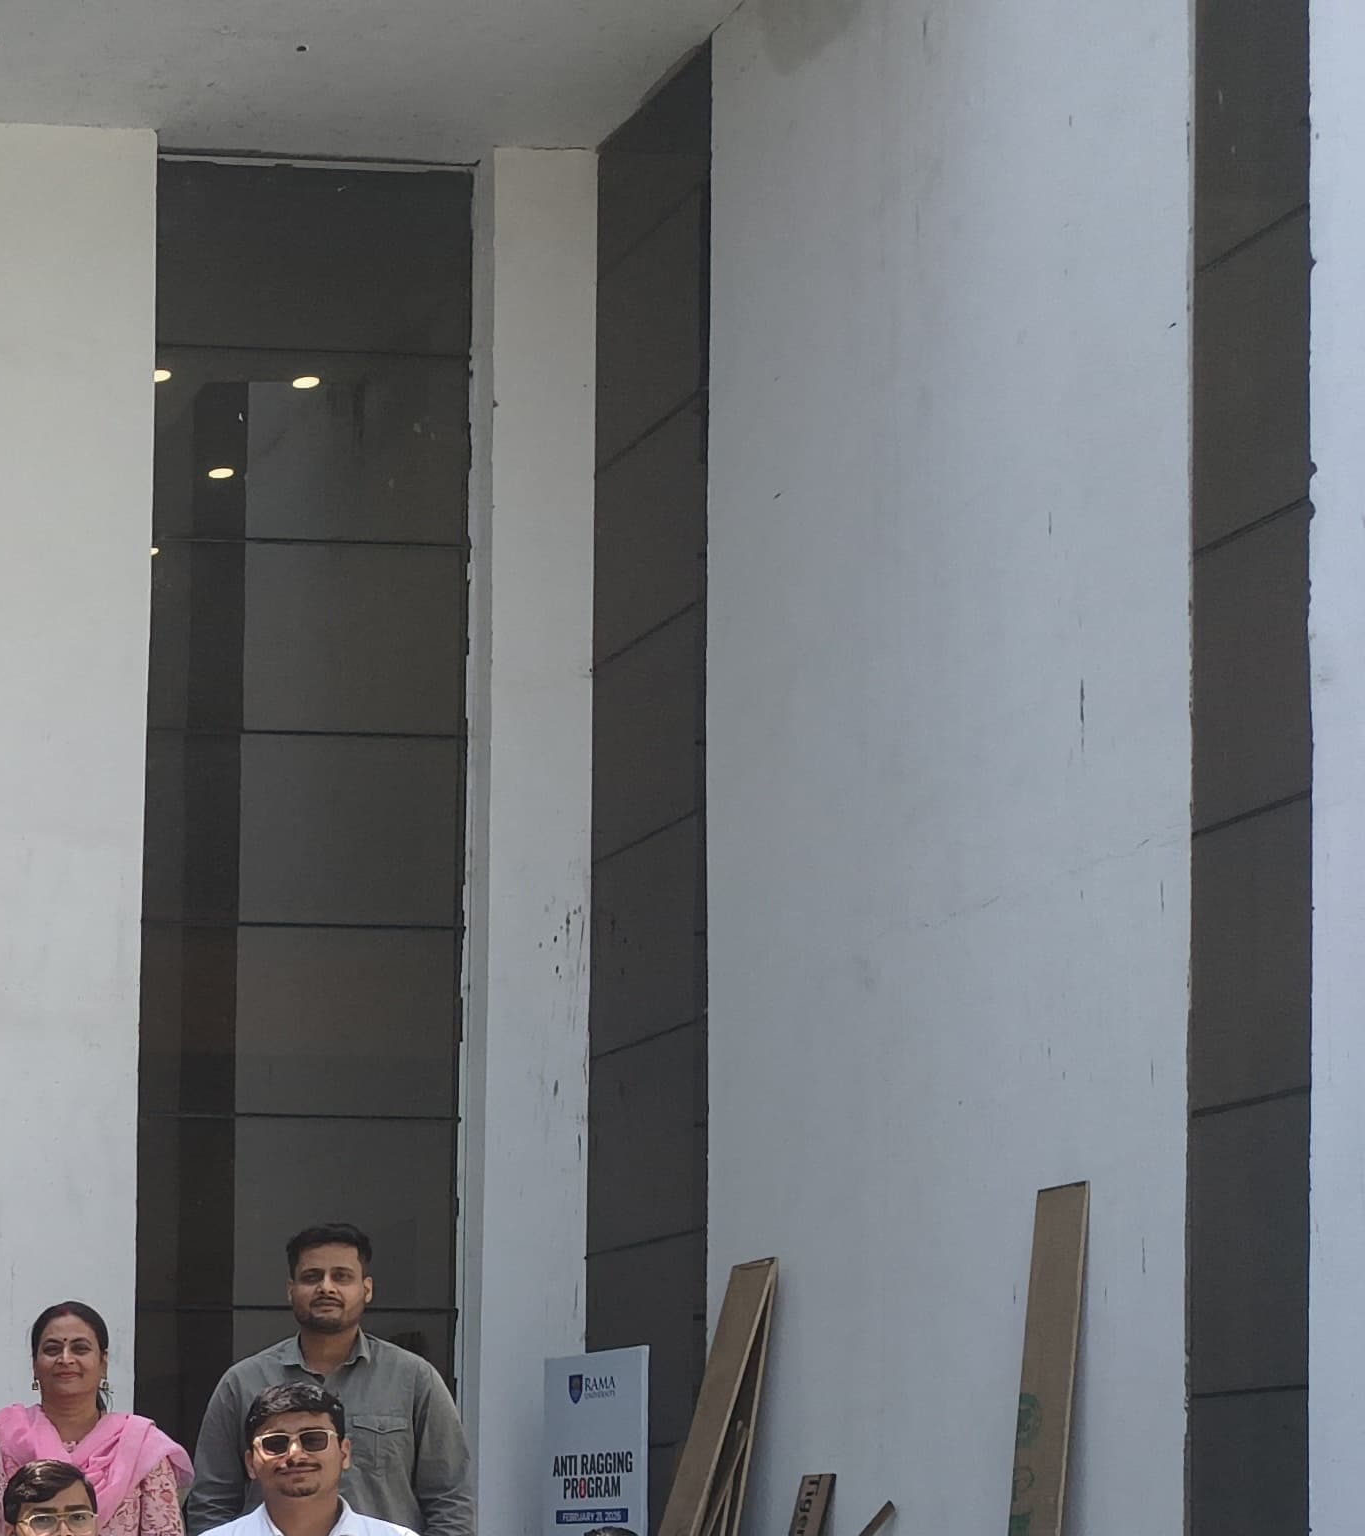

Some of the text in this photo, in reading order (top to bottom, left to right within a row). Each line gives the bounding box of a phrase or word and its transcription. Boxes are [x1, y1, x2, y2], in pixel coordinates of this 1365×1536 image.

[584, 1375, 616, 1391] RAMA
[552, 1451, 633, 1477] ANTI RAGGING
[563, 1476, 621, 1500] PROGRAM
[562, 1512, 595, 1522] FEBRUARY
